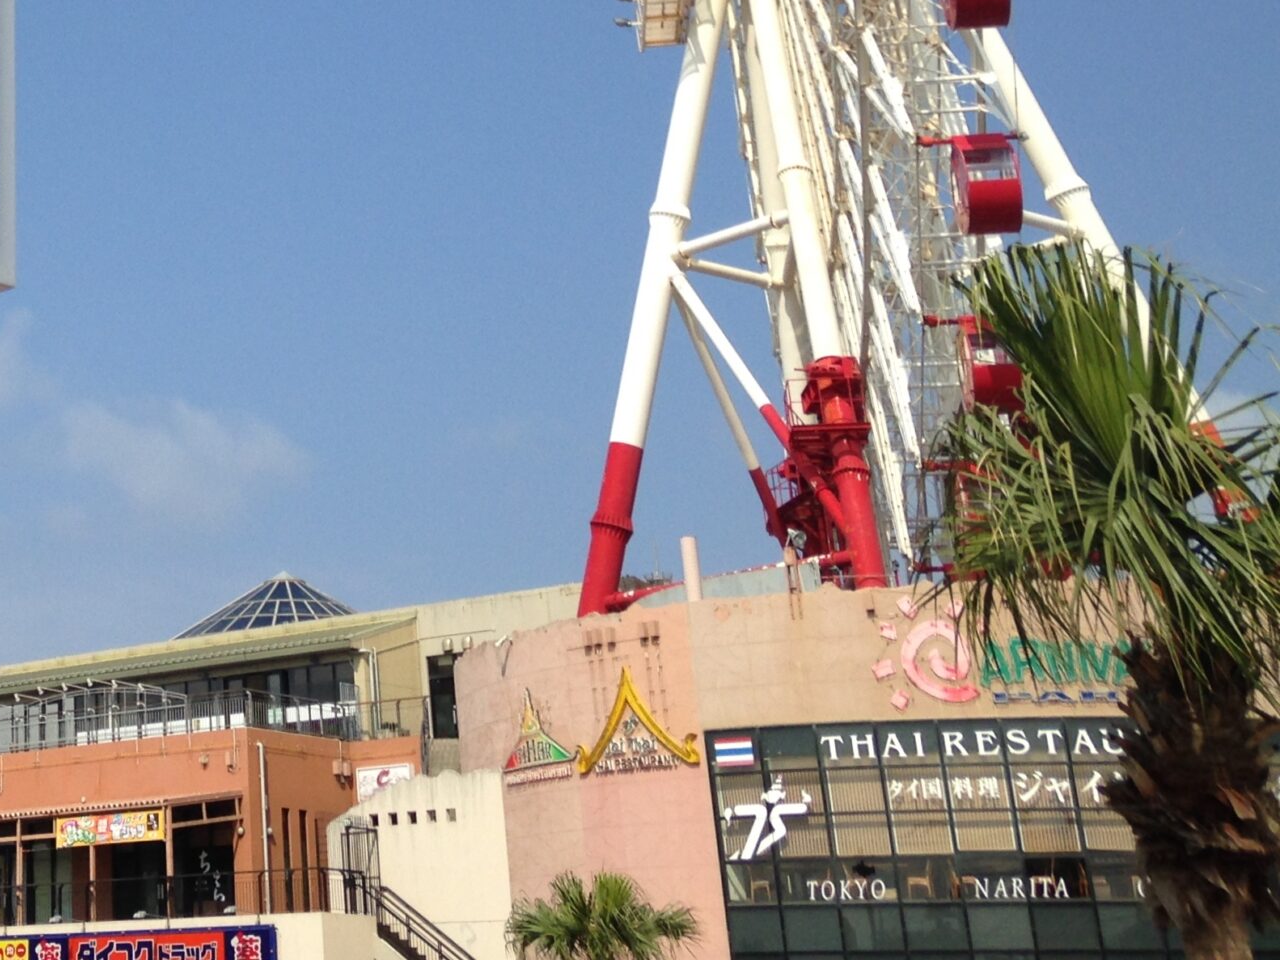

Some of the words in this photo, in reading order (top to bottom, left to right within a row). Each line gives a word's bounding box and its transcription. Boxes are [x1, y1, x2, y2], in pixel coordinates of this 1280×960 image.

[820, 731, 925, 761] THAI
[945, 728, 1124, 758] RESTAU
[807, 878, 886, 901] TOKYO
[974, 877, 1070, 899] NARITA
